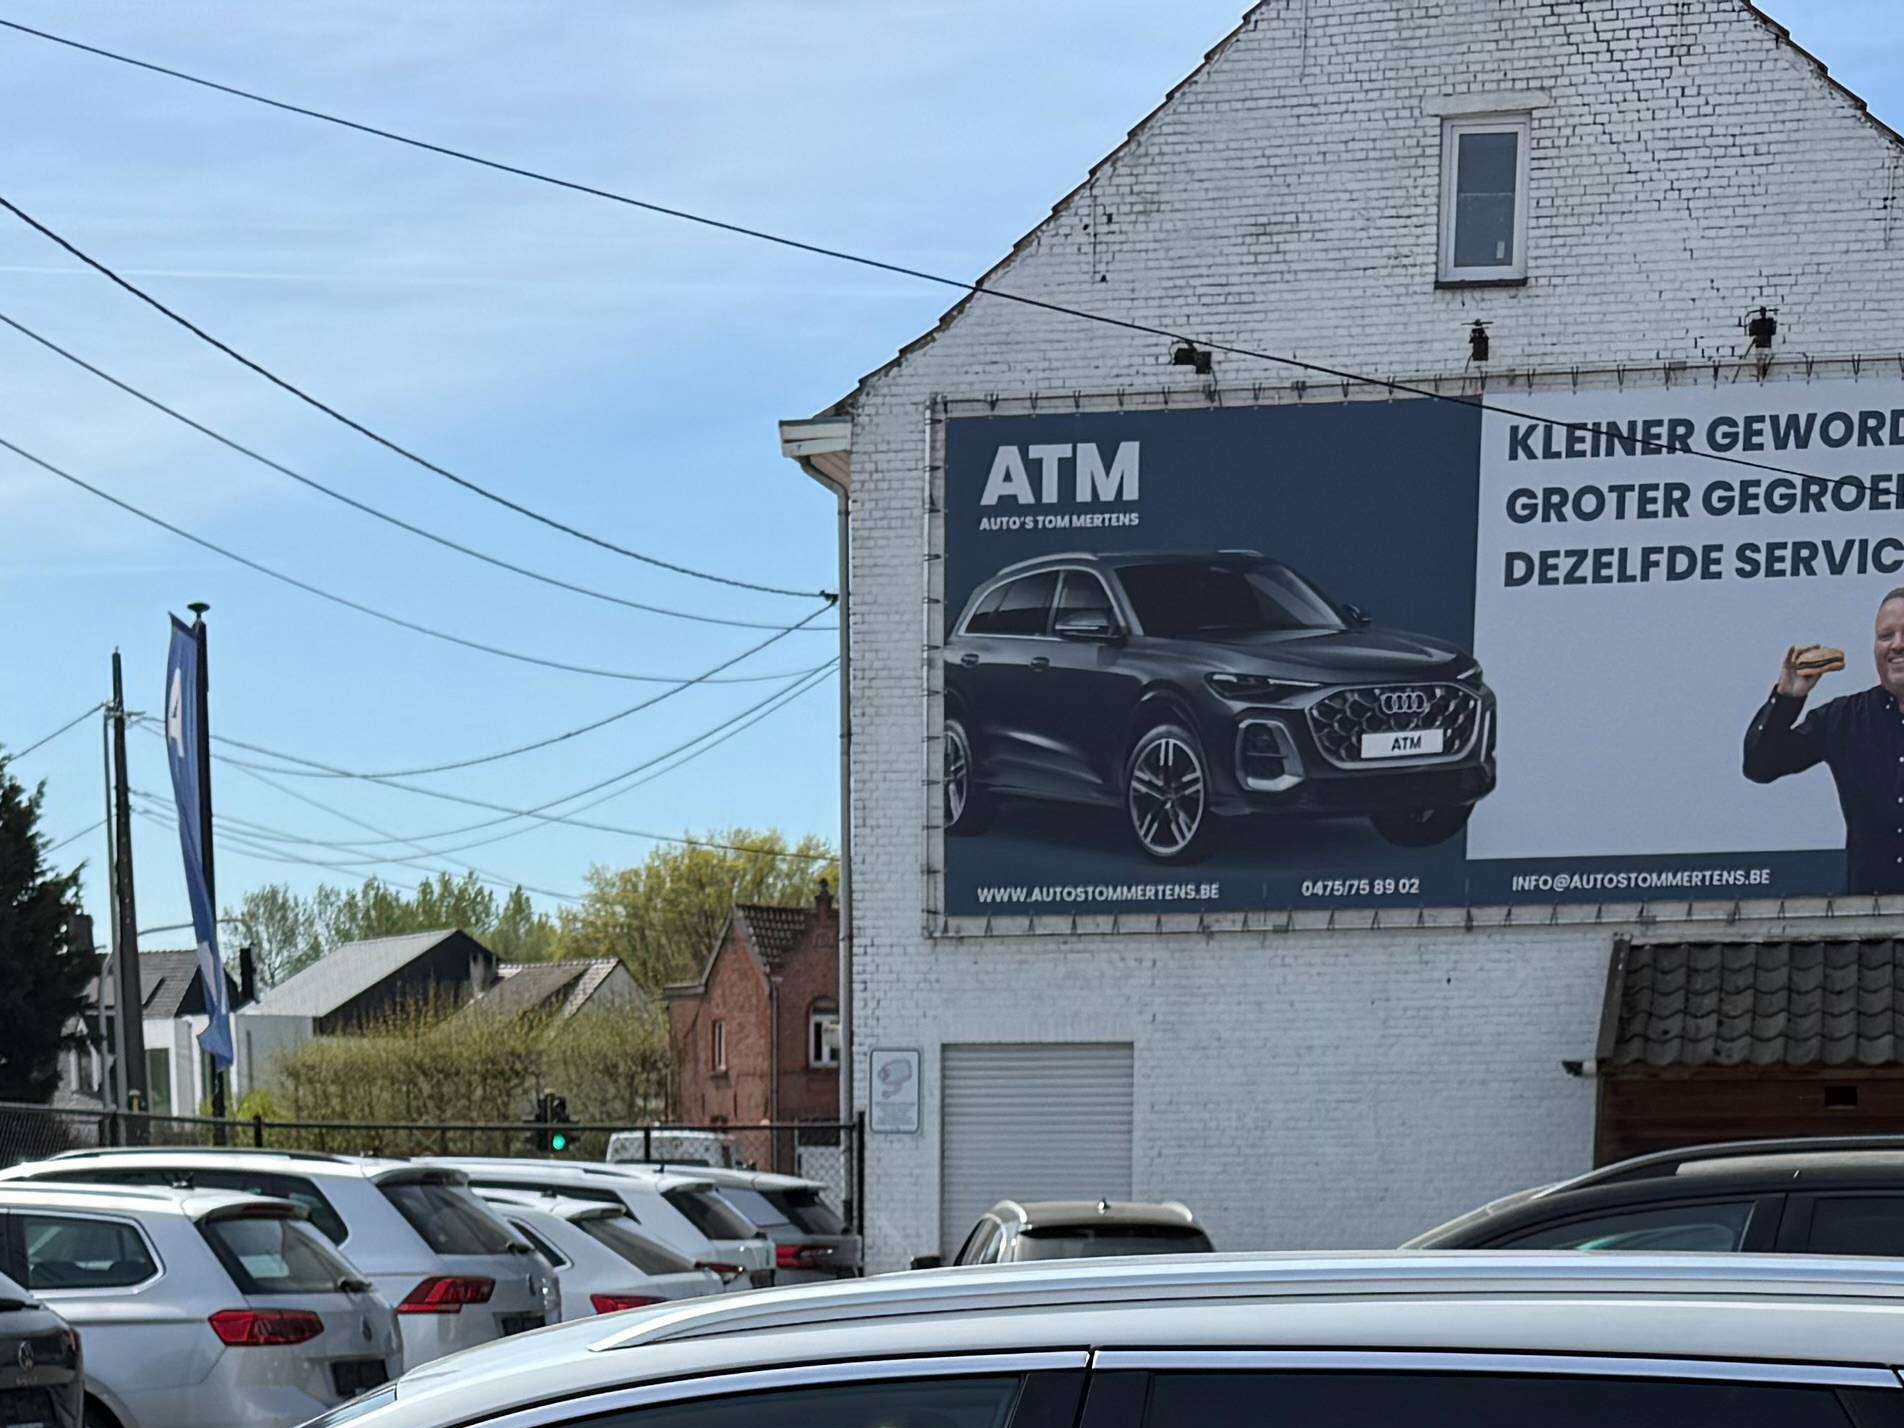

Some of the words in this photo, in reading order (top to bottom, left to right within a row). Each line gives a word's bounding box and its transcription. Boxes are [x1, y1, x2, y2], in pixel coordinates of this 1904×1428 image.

[1507, 418, 1696, 461] KLEINER
[979, 441, 1141, 506] ATM
[1506, 481, 1692, 524] GROTER
[979, 516, 1034, 531] AUTO'S
[1036, 514, 1071, 530] TOM
[1071, 512, 1139, 528] MERTENS
[1503, 543, 1725, 588] DEZELFDE
[1391, 735, 1422, 752] ATM
[976, 883, 1221, 903] WWW.AUTOSTOMMERTENS.BE
[1301, 879, 1370, 898] 0475/75
[1373, 879, 1395, 896] 89
[1398, 878, 1421, 895] 02
[1511, 869, 1772, 892] INFO@AUTOSTOMMERTENS.BE
